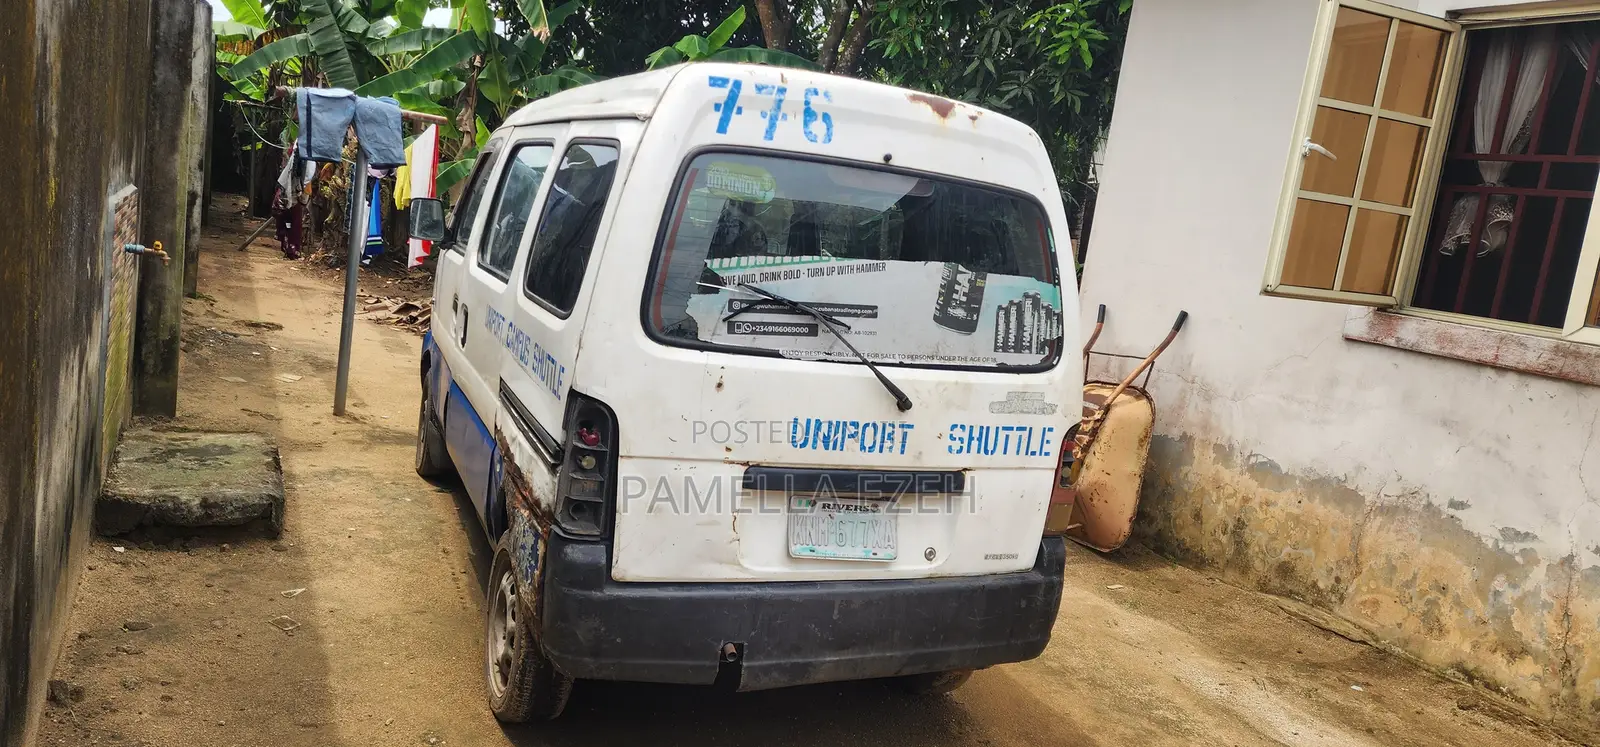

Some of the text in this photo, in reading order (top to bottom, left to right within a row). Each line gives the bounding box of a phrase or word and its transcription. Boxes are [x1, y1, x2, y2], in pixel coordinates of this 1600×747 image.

[709, 76, 833, 144] 776
[706, 174, 761, 197] DOMINION
[760, 271, 782, 283] DRINK
[784, 269, 801, 281] BOLD
[807, 267, 825, 278] TURN
[826, 266, 836, 276] UP
[837, 264, 855, 275] WITH
[856, 262, 886, 274] HAMMER
[752, 325, 809, 334] +2349166069000
[506, 321, 531, 367] CAMPUS
[532, 342, 565, 401] SHUTTLE
[791, 417, 1055, 456] UNIPORT SHUTTLE
[822, 503, 869, 512] RIVERS
